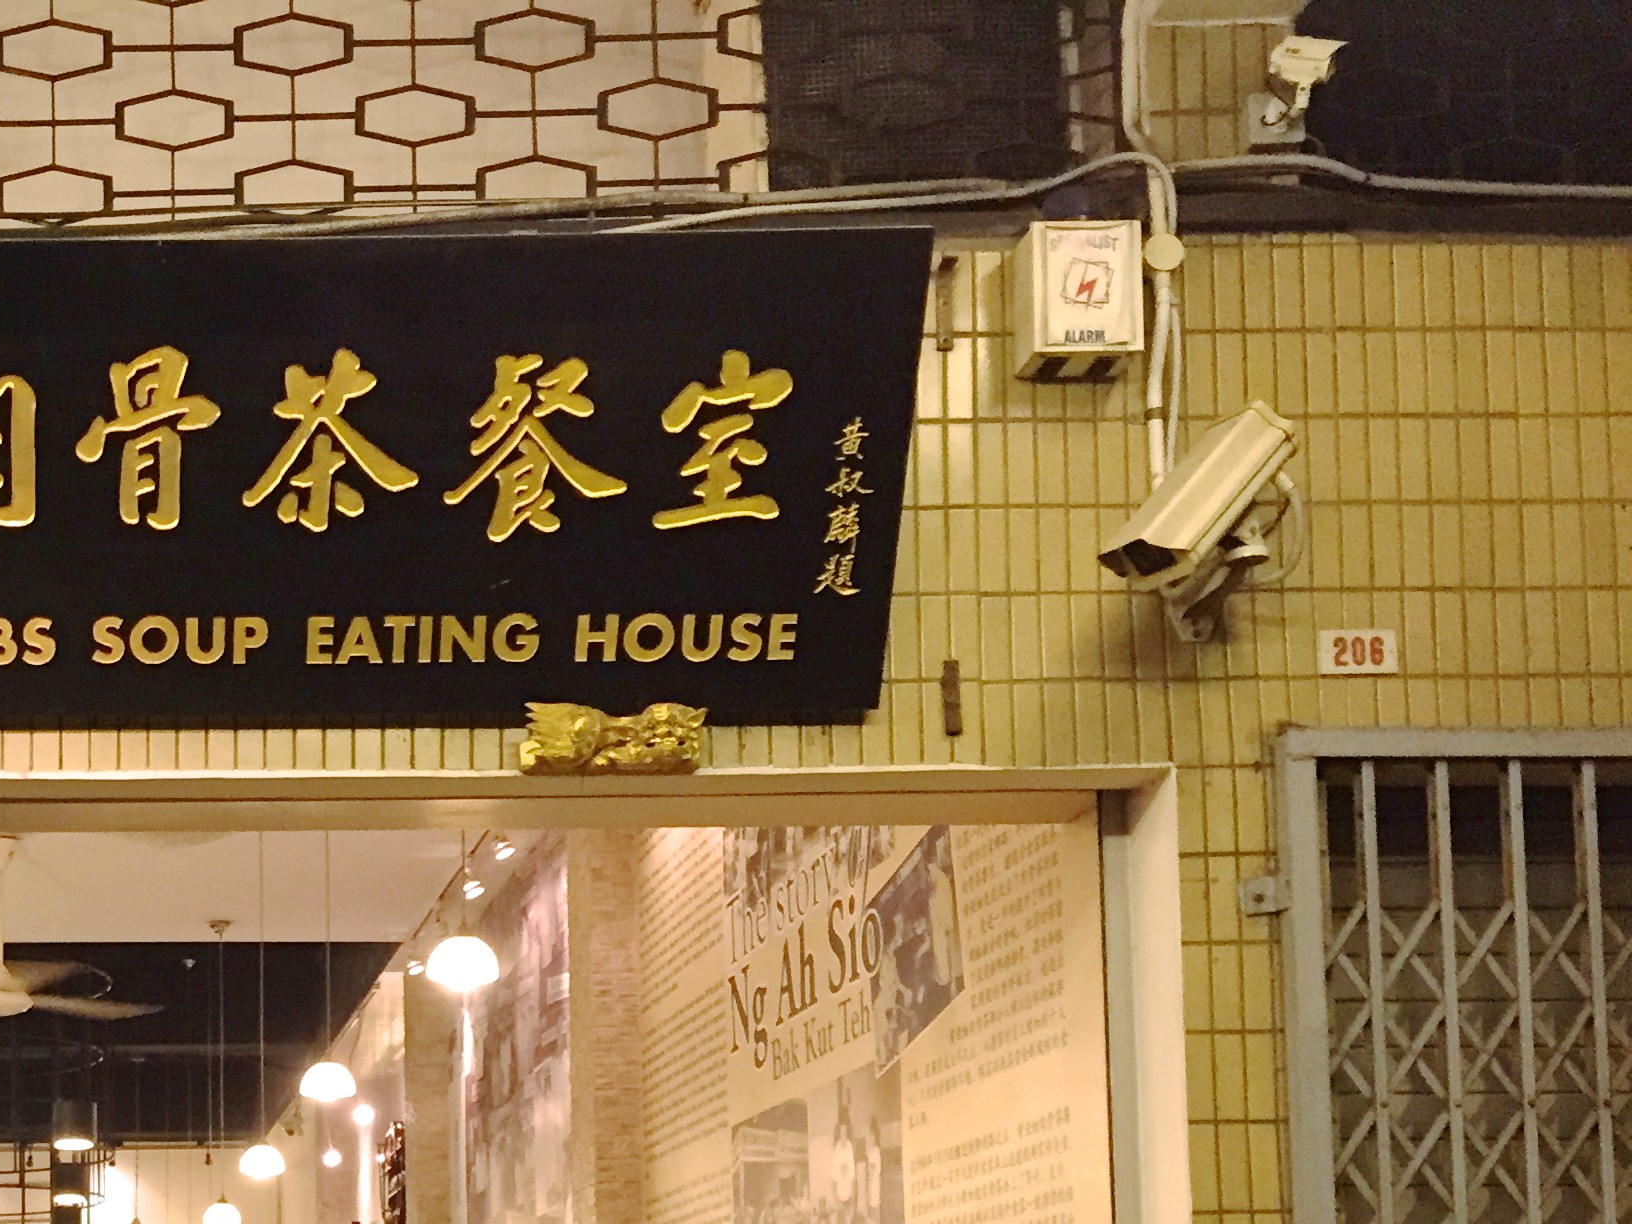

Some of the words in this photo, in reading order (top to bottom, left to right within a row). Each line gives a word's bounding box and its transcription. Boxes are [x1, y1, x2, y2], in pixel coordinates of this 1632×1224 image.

[1064, 329, 1106, 344] ALARM
[91, 615, 268, 666] SOUP
[305, 613, 541, 664] EATING
[574, 612, 799, 663] HOUSE
[1333, 636, 1385, 666] 206
[726, 895, 767, 965] The
[728, 964, 768, 1069] Ng
[775, 921, 818, 1027] Ah
[828, 894, 882, 994] Sio
[771, 1028, 800, 1081] Bak
[803, 1016, 835, 1064] Kut
[838, 988, 871, 1046] Teh
